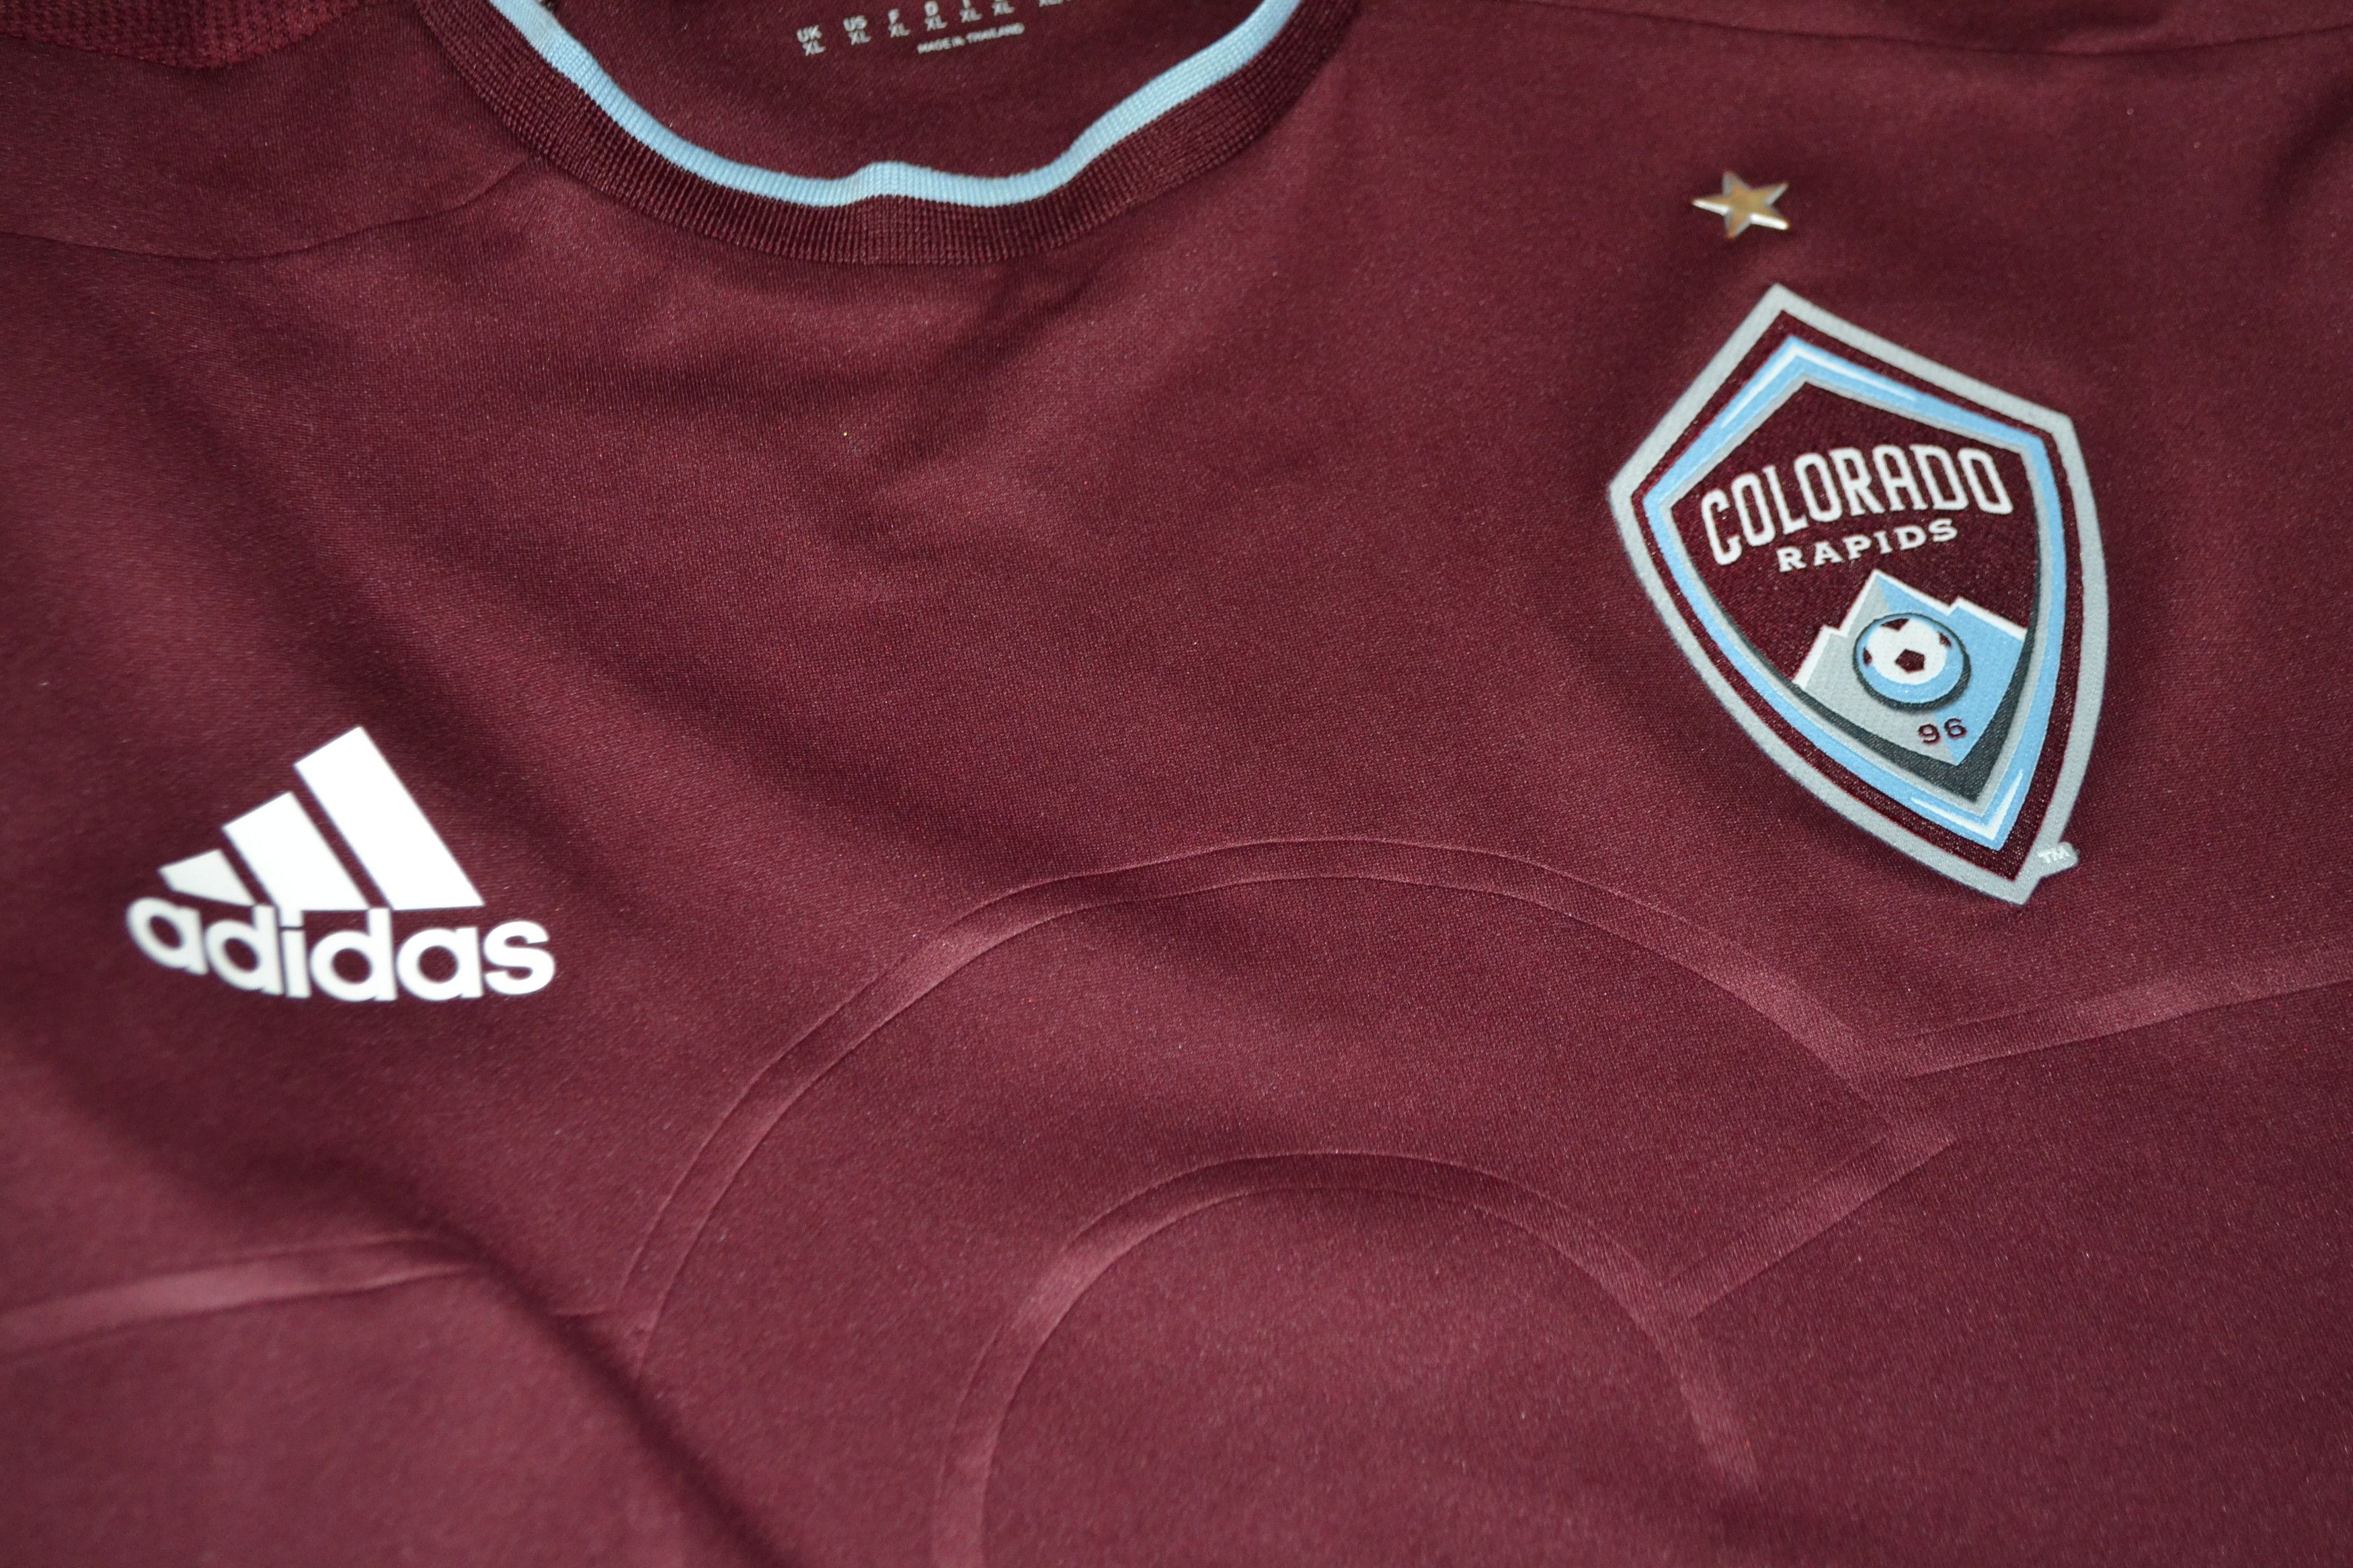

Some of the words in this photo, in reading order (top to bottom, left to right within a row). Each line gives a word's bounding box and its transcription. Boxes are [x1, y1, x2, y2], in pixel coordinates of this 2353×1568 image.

[797, 25, 822, 42] UK
[802, 40, 826, 56] XL
[848, 30, 871, 46] XL
[888, 23, 911, 38] XL
[924, 15, 948, 32] XL
[959, 7, 983, 23] XL
[992, 1, 1015, 16] XL
[917, 37, 951, 54] MADE
[965, 22, 1025, 44] THAILAND
[1700, 444, 2013, 566] COLORADO
[1776, 518, 1958, 573] RAPIDS
[1917, 717, 1967, 745] 96
[2037, 848, 2071, 865] TM
[126, 897, 557, 1002] adidas
